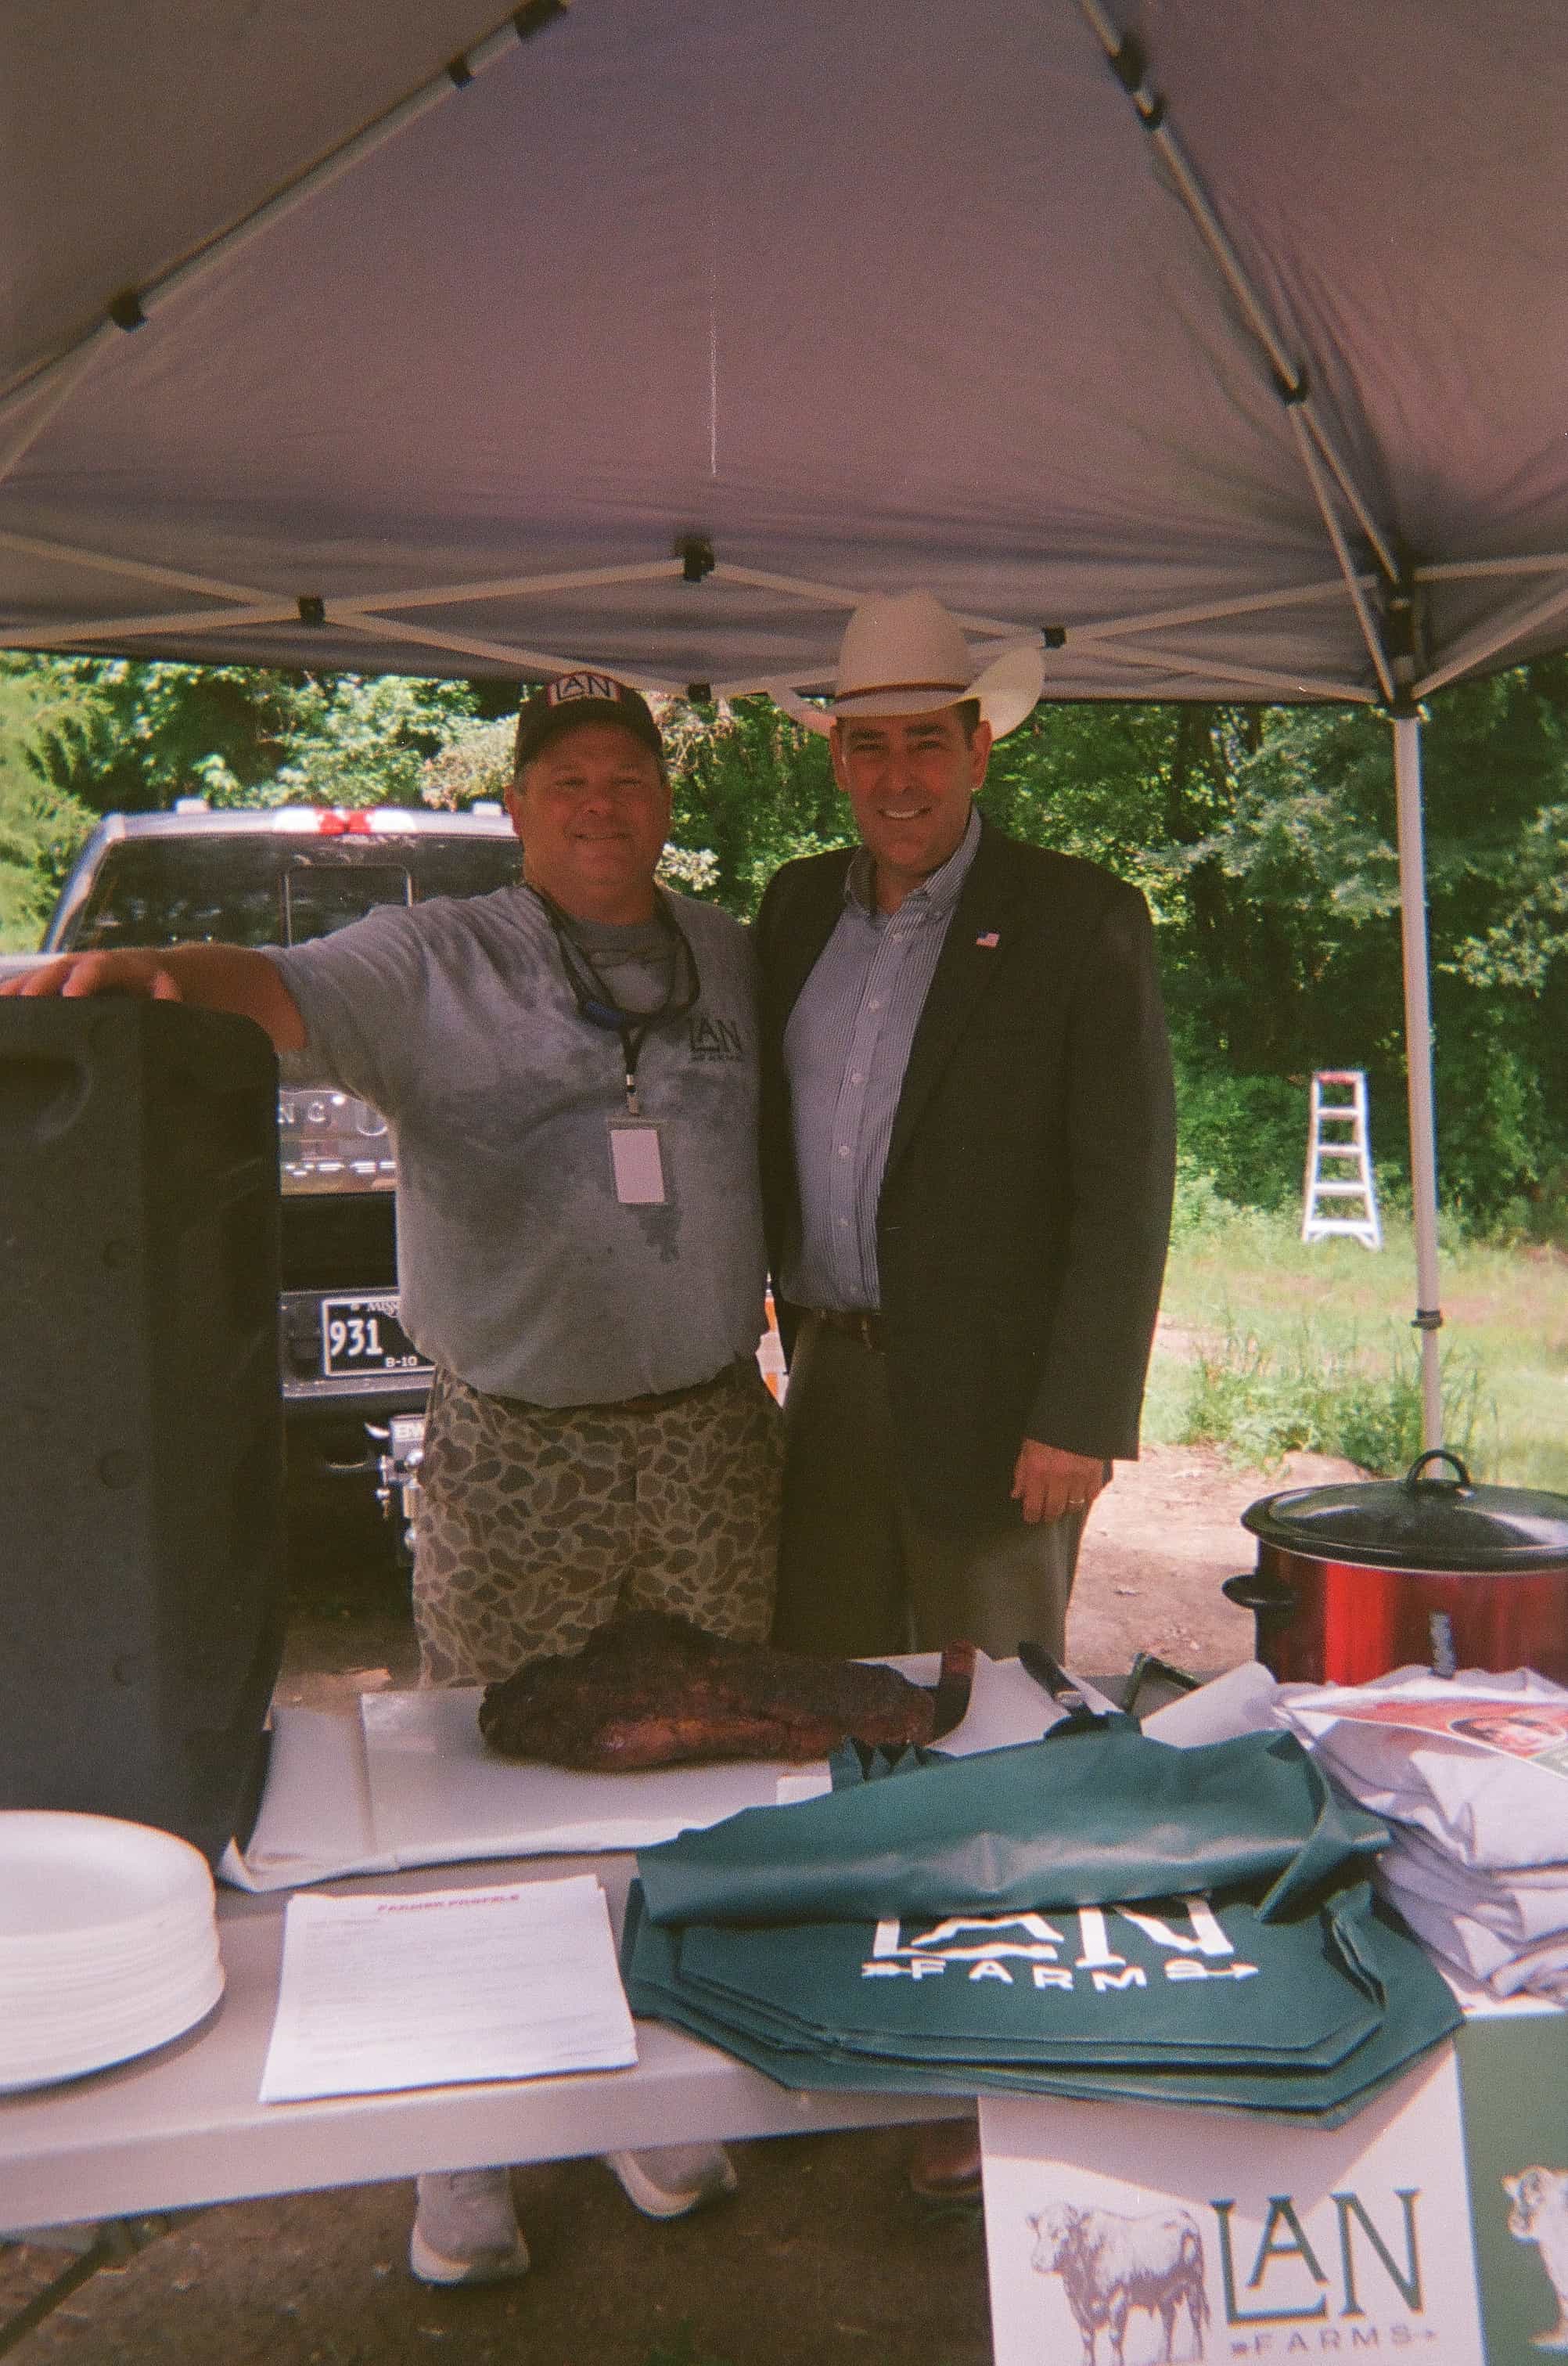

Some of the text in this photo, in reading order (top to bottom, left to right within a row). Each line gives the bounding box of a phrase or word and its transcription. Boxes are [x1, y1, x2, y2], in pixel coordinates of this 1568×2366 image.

[556, 674, 612, 701] LAN
[689, 1017, 743, 1053] LAN
[329, 1318, 384, 1357] 931
[910, 1957, 1209, 1992] FARMS
[1207, 2187, 1425, 2330] LAN
[1253, 2323, 1412, 2354] FARMS
